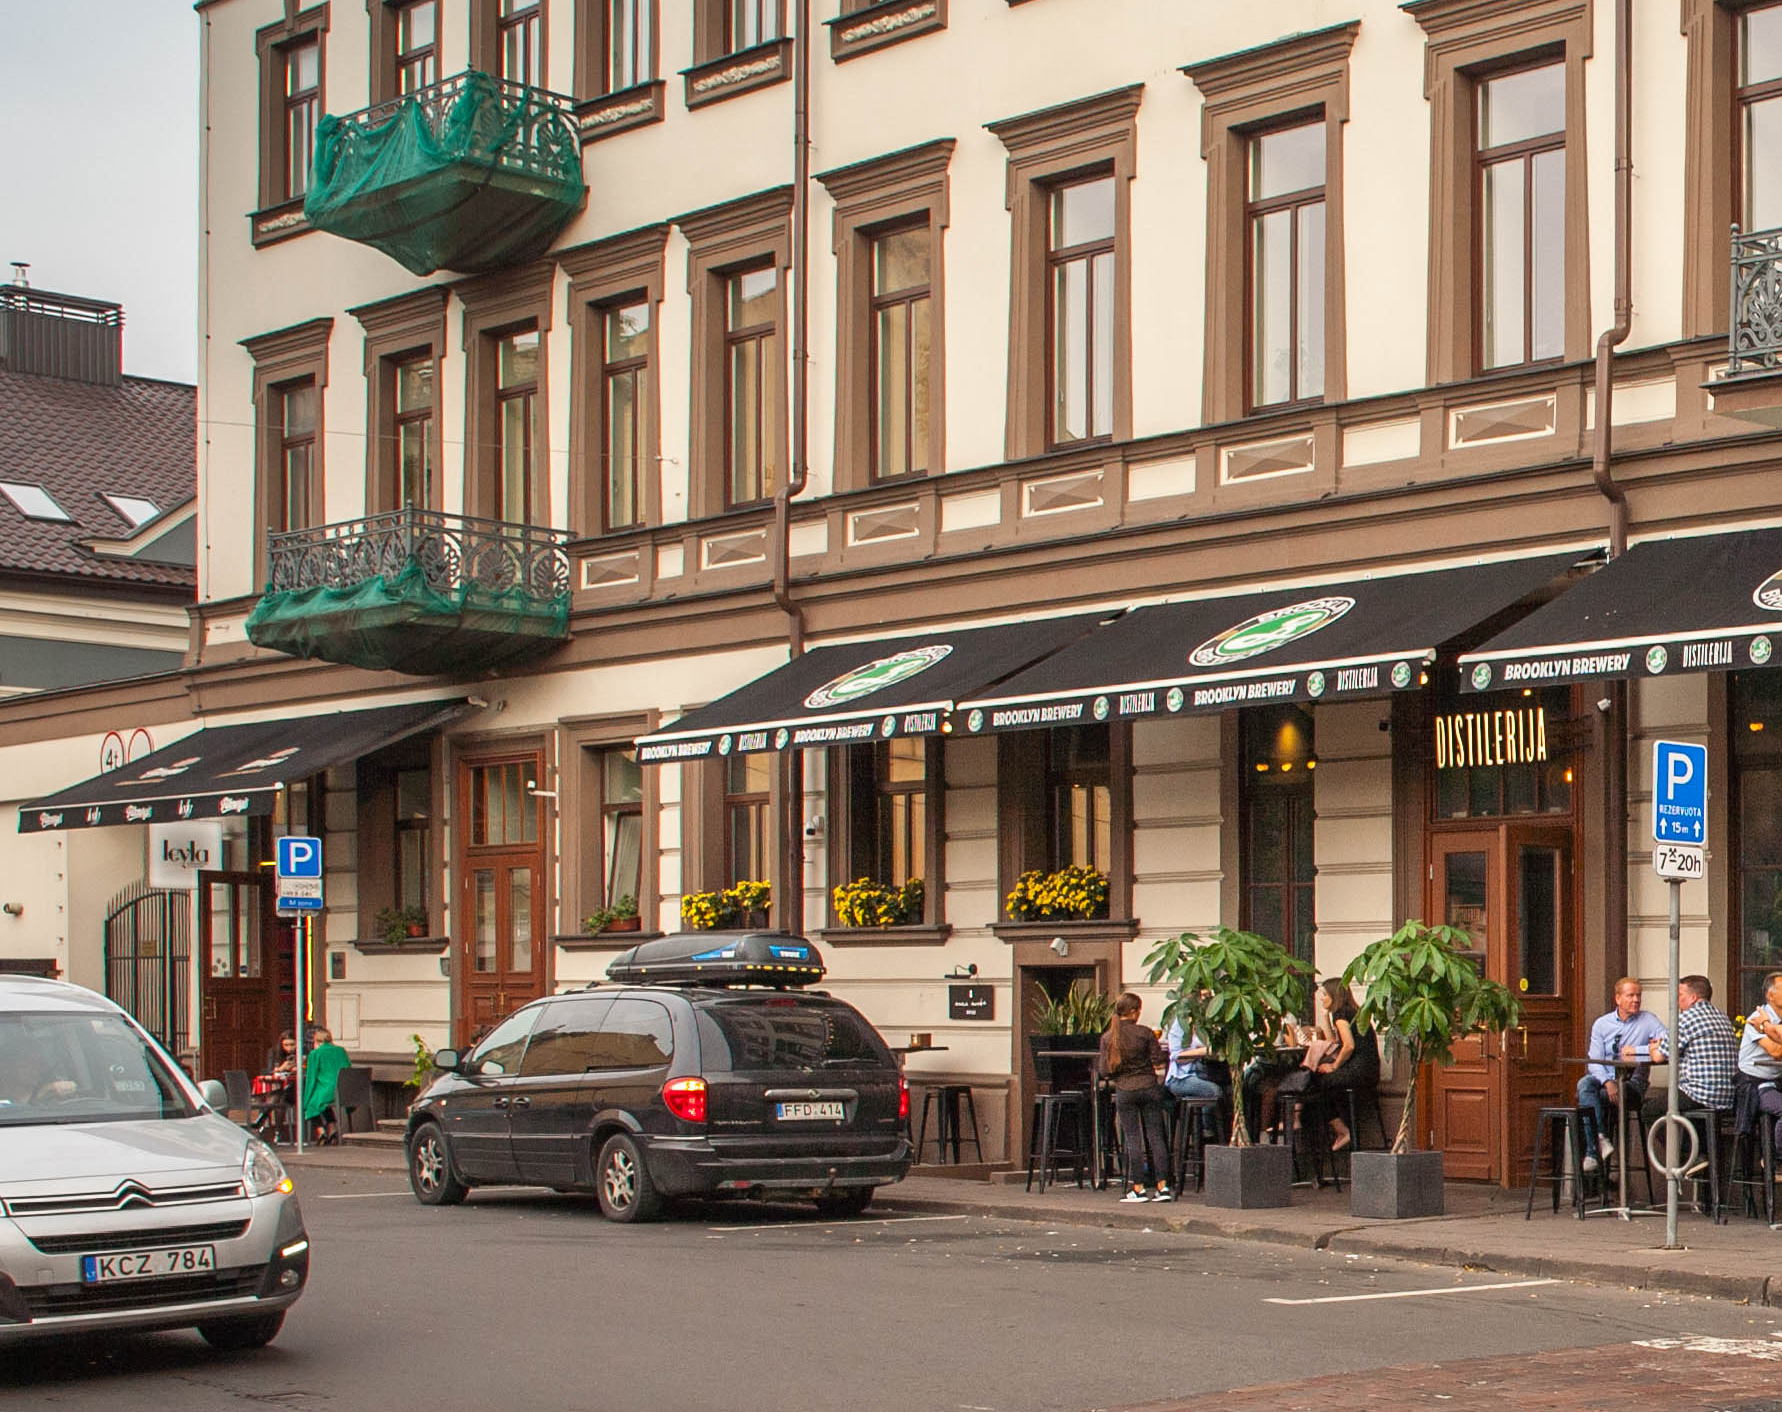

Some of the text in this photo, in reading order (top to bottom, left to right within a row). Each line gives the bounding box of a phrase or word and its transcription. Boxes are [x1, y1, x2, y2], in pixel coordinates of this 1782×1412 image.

[1504, 653, 1631, 680] BROOKLYN BREWERY
[1683, 641, 1733, 668] DISTILERIJA
[1337, 666, 1379, 691] DISTILERIJA
[1194, 679, 1296, 706] BROOKLYN BREWERY
[992, 703, 1083, 726] BROOKLYN BREWERY
[794, 727, 836, 743] BROOKLYN
[1435, 707, 1547, 769] DISTILERIJA
[1667, 752, 1694, 800] P
[1658, 804, 1702, 817] REZERVUOTA
[163, 839, 209, 868] leyla
[290, 842, 312, 873] P
[784, 1103, 841, 1116] FFD 414
[100, 1249, 210, 1277] KCZ 784
